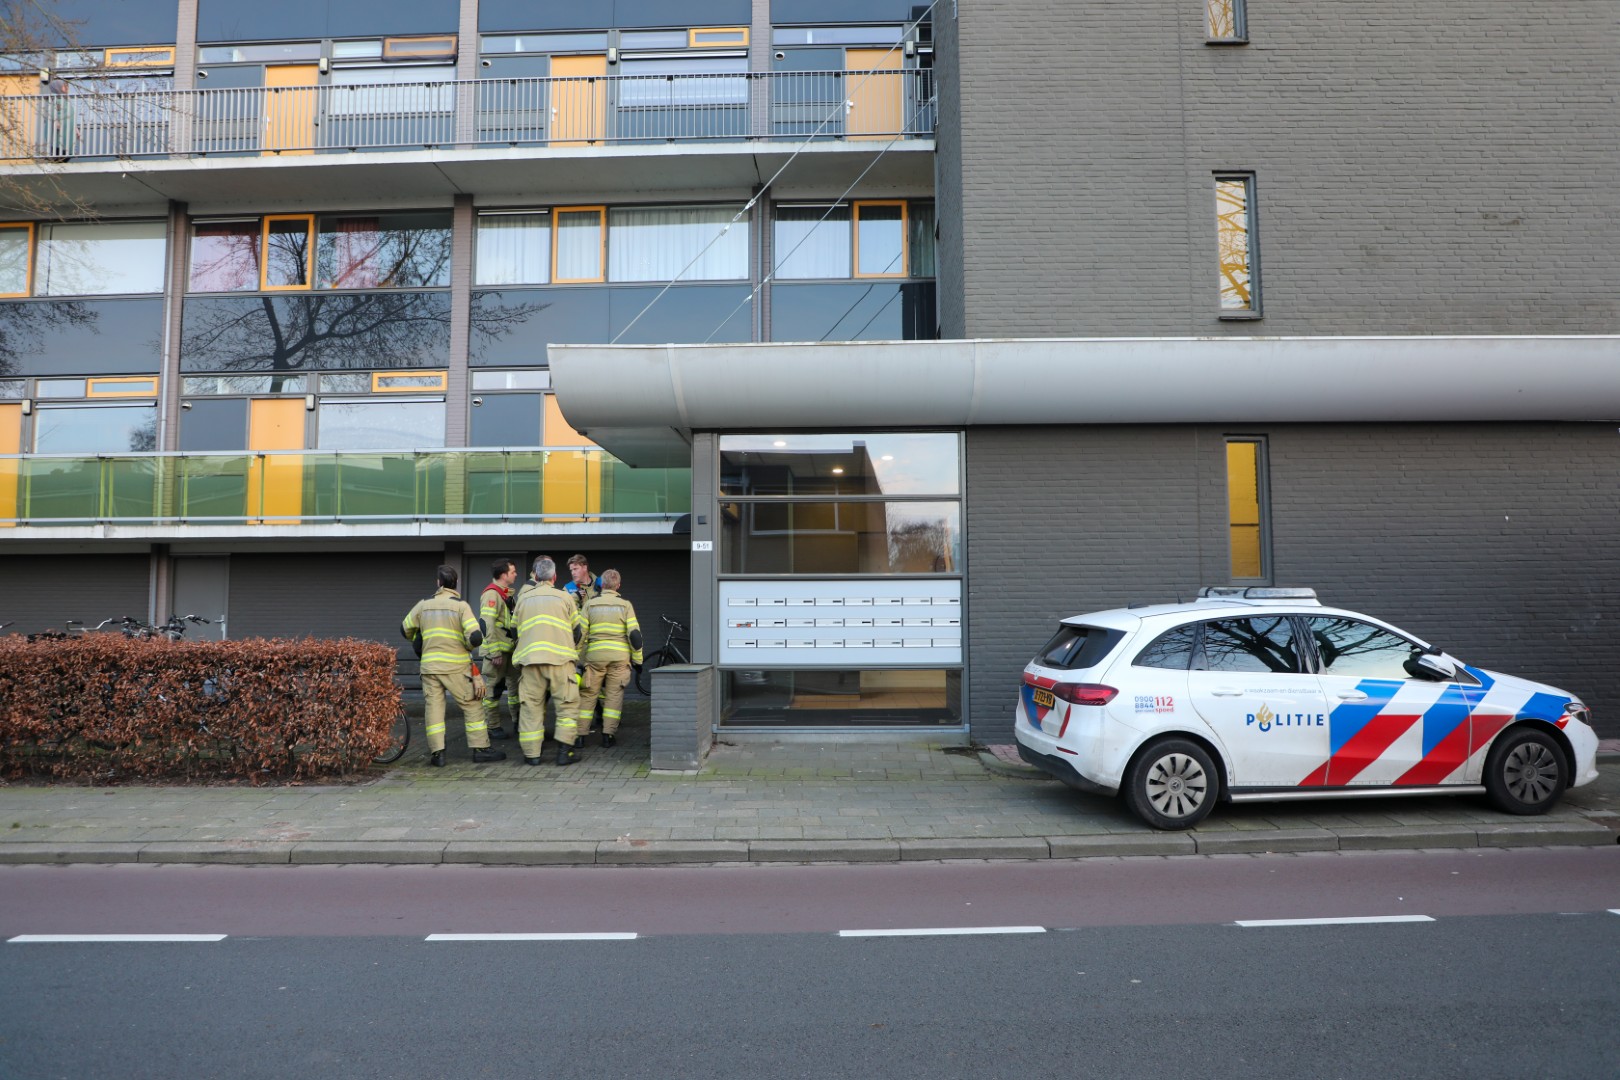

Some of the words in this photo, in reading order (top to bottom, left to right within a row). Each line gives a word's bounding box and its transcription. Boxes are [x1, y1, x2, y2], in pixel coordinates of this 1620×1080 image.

[1154, 695, 1174, 706] 112
[1155, 706, 1174, 714] spoed
[1246, 713, 1324, 732] POLITIE
